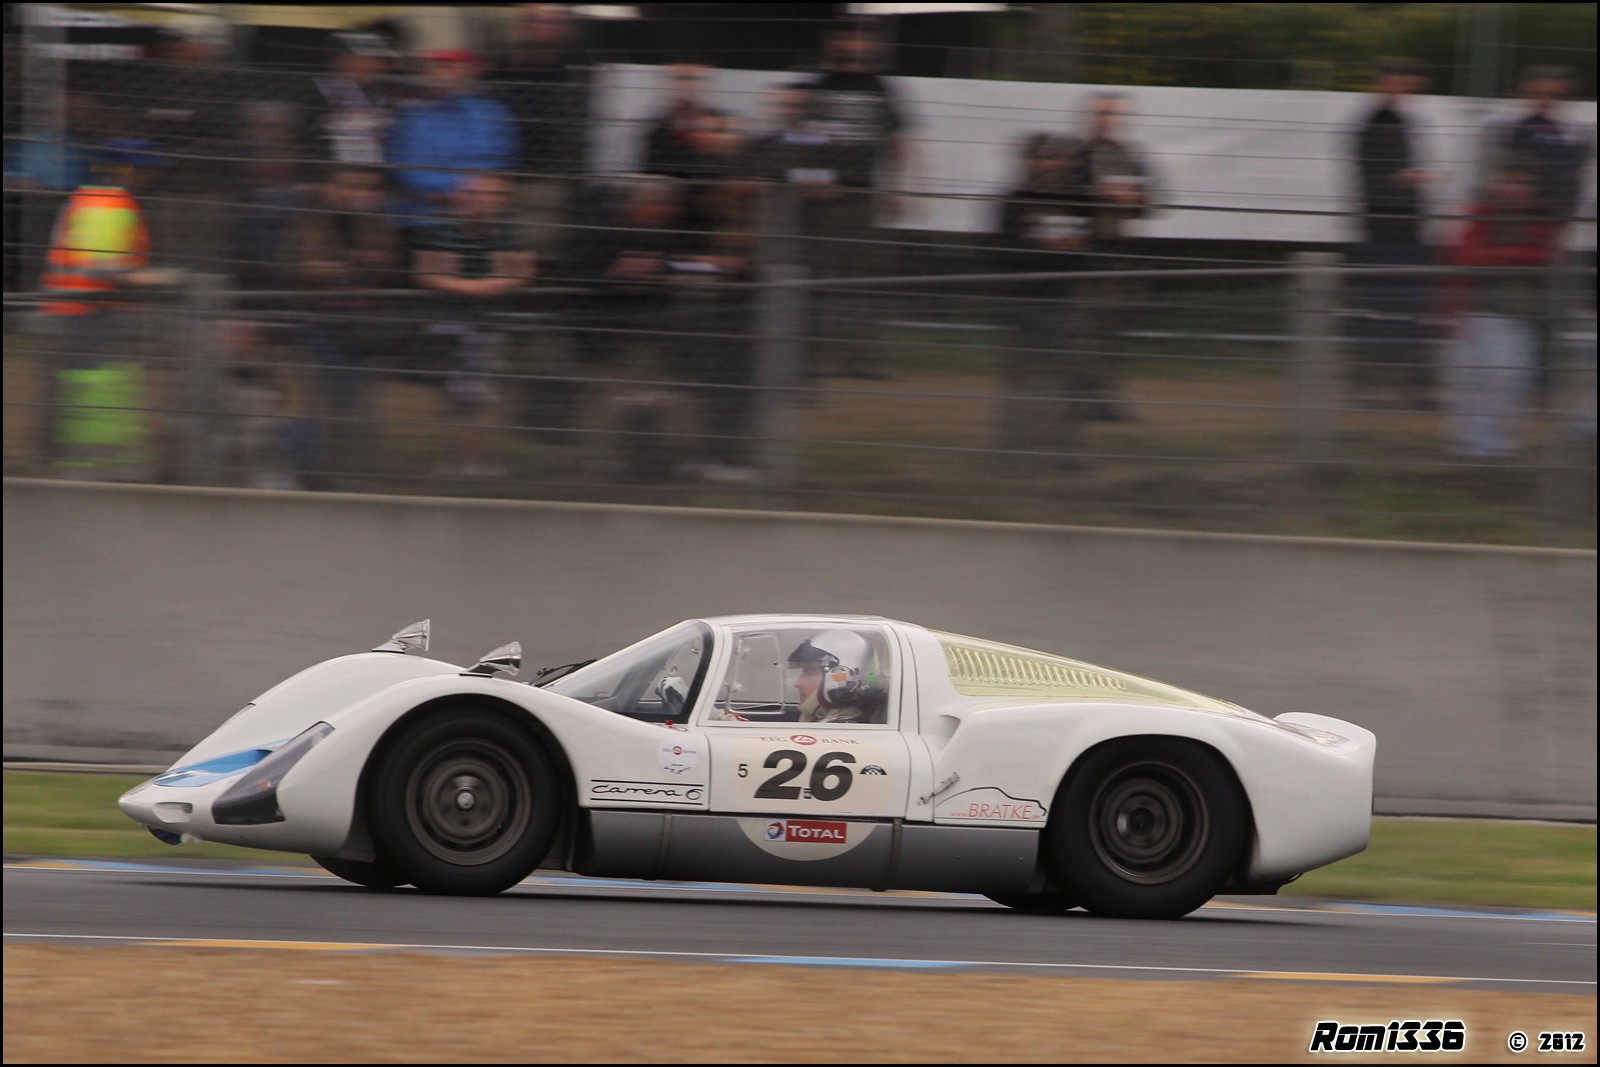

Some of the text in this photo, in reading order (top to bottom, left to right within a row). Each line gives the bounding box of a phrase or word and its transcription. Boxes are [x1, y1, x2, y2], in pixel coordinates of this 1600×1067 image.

[737, 763, 748, 778] 5
[753, 749, 856, 802] 26
[591, 784, 704, 801] Carrera 6
[788, 825, 845, 840] TOTAL
